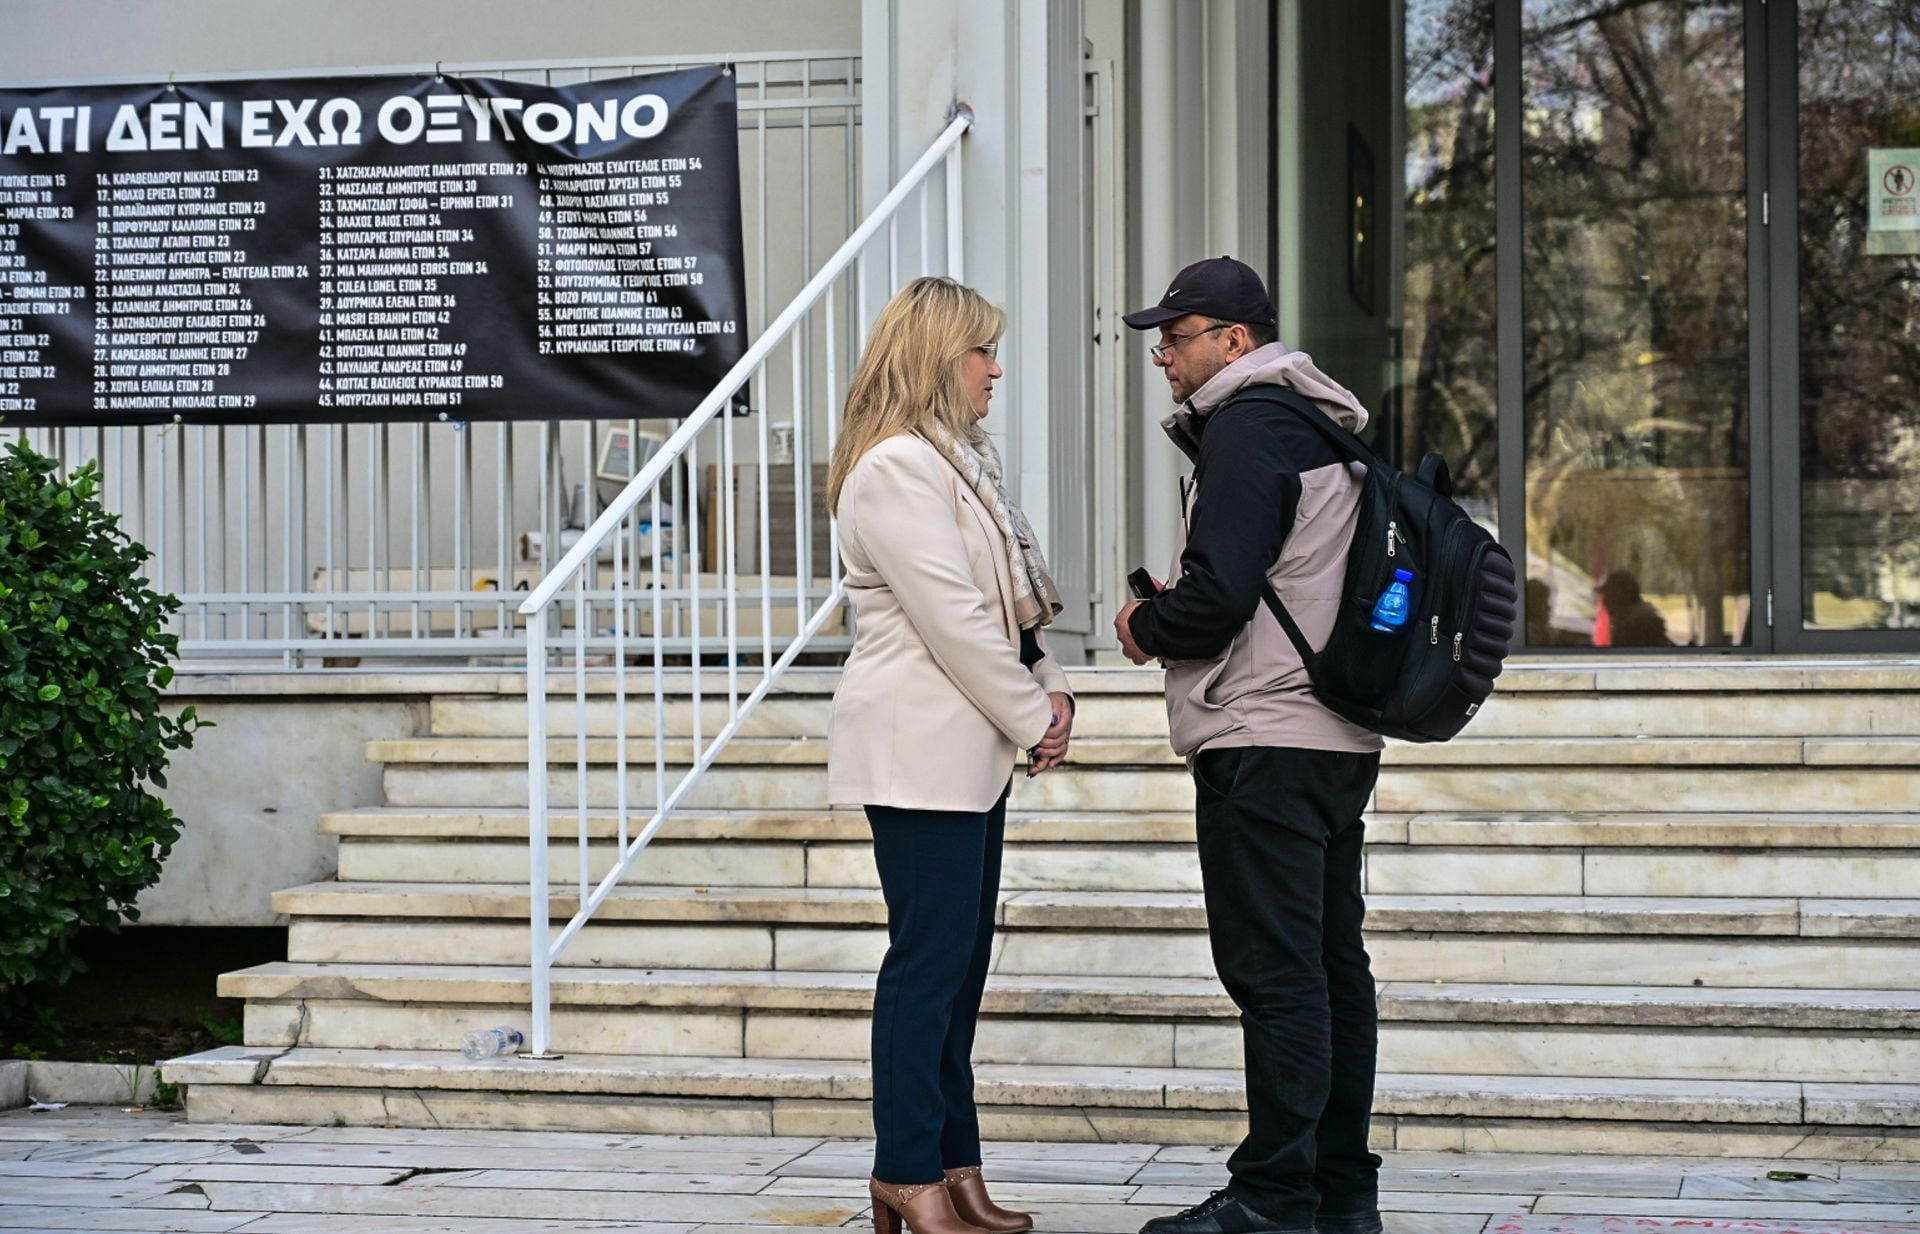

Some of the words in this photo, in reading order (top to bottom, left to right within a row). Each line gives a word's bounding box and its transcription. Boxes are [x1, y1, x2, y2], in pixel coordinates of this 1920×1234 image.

[0, 106, 92, 155] ΑΤΙ
[106, 101, 225, 151] ΔΕΝ
[241, 97, 362, 148] ΕΧΩ
[377, 94, 669, 145] ΟΞΥΓΟΝΟ
[96, 173, 110, 185] 16.
[183, 170, 220, 183] ΝΙΚΗΤΑΣ
[221, 169, 244, 182] ΕΤΩΝ
[246, 169, 258, 181] 23
[318, 167, 333, 179] 31.
[335, 165, 430, 178] ΧΑΤΖΗΧΑΡΑΛΑΜΠΟΥΣ
[432, 163, 487, 176] ΠΑΝΑΓΙΩΤΗΣ
[489, 162, 514, 175] ΕΤΩΝ
[515, 162, 527, 175] 29
[29, 174, 52, 187] ΕΤΩΝ
[54, 174, 65, 186] 15
[319, 183, 334, 195] 32.
[336, 182, 384, 195] ΜΑΣΣΑΛΗΣ
[385, 181, 438, 194] ΔΗΜΗΤΡΙΟΣ
[439, 180, 463, 192] ΕΤΩΝ
[464, 179, 477, 192] 30
[96, 189, 110, 201] 17.
[112, 188, 144, 200] ΜΟΛΧΟ
[146, 187, 177, 200] ΕΡΙΕΤΑ
[178, 187, 201, 199] ΕΤΩΝ
[203, 186, 215, 198] 23
[6, 207, 35, 219] ΜΑΡΙΑ
[35, 206, 59, 219] ΕΤΩΝ
[61, 206, 73, 218] 20
[96, 221, 110, 233] 19.
[112, 220, 169, 233] ΠΟΡΦΥΡΙΔΟΥ
[171, 219, 216, 231] ΚΑΛΛΙΟΠΗ
[218, 218, 241, 230] ΕΤΩΝ
[243, 217, 255, 230] 23
[319, 216, 334, 228] 34.
[336, 215, 372, 228] ΒΛΑΧΟΣ
[374, 214, 401, 227] ΒΑΙΟΣ
[402, 214, 426, 226] ΕΤΩΝ
[428, 213, 441, 225] 34
[94, 237, 110, 249] 20.
[111, 236, 160, 249] ΤΣΑΚΛΙΔΟΥ
[161, 235, 190, 248] ΑΓΑΠΗ
[192, 235, 215, 247] ΕΤΩΝ
[217, 234, 229, 247] 23
[319, 232, 334, 244] 35.
[336, 231, 387, 244] ΒΟΥΛΓΑΡΗΣ
[388, 230, 434, 243] ΣΠΥΡΙΔΩΝ
[435, 229, 459, 242] ΕΤΩΝ
[461, 228, 473, 241] 34
[94, 253, 109, 265] 21.
[167, 251, 206, 263] ΑΓΓΕΛΟΣ
[208, 250, 231, 263] ΕΤΩΝ
[233, 250, 245, 262] 23
[319, 248, 334, 260] 36.
[336, 247, 376, 260] ΚΑΤΣΑΡΑ
[377, 247, 410, 259] ΑΘΗΝΑ
[411, 246, 435, 259] ΕΤΩΝ
[437, 246, 449, 258] 34
[537, 259, 552, 271] 52.
[617, 258, 655, 271] ΓΕΩΡΓΙΟΣ
[656, 256, 682, 270] ΕΤΩΝ
[683, 256, 697, 269] 57
[537, 275, 552, 288] 53.
[554, 274, 621, 288] ΚΟΥΤΣΟΥΜΠΑΣ
[623, 274, 662, 287] ΓΕΩΡΓΙΟΣ
[662, 272, 688, 286] ΕΤΩΝ
[689, 272, 704, 285] 58
[95, 285, 109, 297] 23.
[111, 284, 153, 297] ΑΔΑΜΙΔΗ
[154, 283, 202, 296] ΑΝΑΣΤΑΣΙΑ
[203, 283, 226, 295] ΕΤΩΝ
[228, 282, 240, 294] 24
[95, 301, 109, 313] 24.
[111, 300, 160, 313] ΑΣΛΑΝΙΔΗΣ
[162, 299, 213, 312] ΔΗΜΗΤΡΙΟΣ
[215, 299, 238, 311] ΕΤΩΝ
[239, 298, 252, 310] 26
[537, 308, 552, 320] 55.
[554, 307, 599, 320] ΚΑΡΙΩΤΗΣ
[600, 306, 643, 320] ΙΩΑΝΝΗΣ
[643, 306, 668, 319] ΕΤΩΝ
[670, 306, 682, 318] 63
[94, 317, 109, 329] 25.
[111, 316, 183, 328] ΧΑΤΖΗΒΑΣΙΛΕΙΟΥ
[228, 314, 251, 326] ΕΤΩΝ
[253, 314, 265, 326] 26
[538, 324, 552, 337] 56.
[555, 324, 578, 336] ΝΤΟΣ
[579, 323, 614, 336] ΣΑΝΤΟΣ
[615, 322, 643, 335] ΣΙΛΒΑ
[645, 322, 695, 335] ΕΥΑΓΓΕΛΙΑ
[696, 320, 720, 334] ΕΤΩΝ
[722, 320, 736, 333] 63
[93, 333, 109, 345] 26.
[111, 332, 176, 345] ΚΑΡΑΓΕΩΡΓΙΟΥ
[178, 331, 219, 344] ΣΩΤΗΡΙΟΣ
[221, 331, 244, 343] ΕΤΩΝ
[246, 330, 258, 343] 27
[318, 329, 334, 341] 41.
[336, 328, 375, 341] ΜΠΛΕΚΑ
[376, 328, 399, 340] ΒΑΙΑ
[400, 327, 424, 340] ΕΤΩΝ
[425, 327, 438, 340] 42
[318, 345, 334, 358] 42.
[336, 344, 384, 357] ΒΟΥΤΣΙΝΑΣ
[386, 344, 426, 356] ΙΩΑΝΝΗΣ
[428, 343, 452, 356] ΕΤΩΝ
[453, 343, 466, 355] 49
[538, 341, 553, 354] 57.
[555, 340, 609, 353] ΚΥΡΙΑΚΙΔΗΣ
[611, 339, 654, 352] ΓΕΩΡΓΙΟΣ
[656, 338, 681, 351] ΕΤΩΝ
[682, 338, 695, 351] 67
[93, 348, 108, 360] 27.
[110, 348, 167, 361] ΚΑΡΑΣΑΒΒΑΣ
[169, 348, 208, 360] ΙΩΑΝΝΗΣ
[210, 347, 233, 359] ΕΤΩΝ
[235, 347, 247, 359] 27
[93, 364, 108, 376] 28.
[110, 364, 137, 376] ΟΙΚΟΥ
[138, 364, 190, 376] ΔΗΜΗΤΡΙΟΣ
[192, 363, 215, 375] ΕΤΩΝ
[217, 363, 229, 375] 28
[318, 361, 334, 374] 43.
[336, 361, 379, 373] ΠΑΥΛΙΔΗΣ
[380, 360, 422, 373] ΑΝΔΡΕΑΣ
[424, 359, 448, 372] ΕΤΩΝ
[449, 359, 462, 371] 49
[318, 378, 333, 390] 44.
[370, 376, 416, 389] ΒΑΣΙΛΕΙΟΣ
[418, 376, 462, 388] ΚΥΡΙΑΚΟΣ
[464, 375, 488, 388] ΕΤΩΝ
[490, 375, 502, 387] 50
[0, 398, 22, 410] ΕΤΩΝ
[23, 398, 35, 410] 22
[93, 397, 107, 408] 30.
[109, 396, 170, 408] ΝΑΛΜΠΑΝΤΗΣ
[171, 395, 216, 408] ΝΙΚΟΛΑΟΣ
[218, 395, 241, 407] ΕΤΩΝ
[243, 394, 256, 406] 29
[318, 393, 333, 406] 45.
[335, 393, 389, 406] ΜΟΥΡΤΖΑΚΗ
[391, 393, 421, 405] ΜΑΡΙΑ
[423, 392, 447, 404] ΕΤΩΝ
[449, 392, 461, 404] 51
